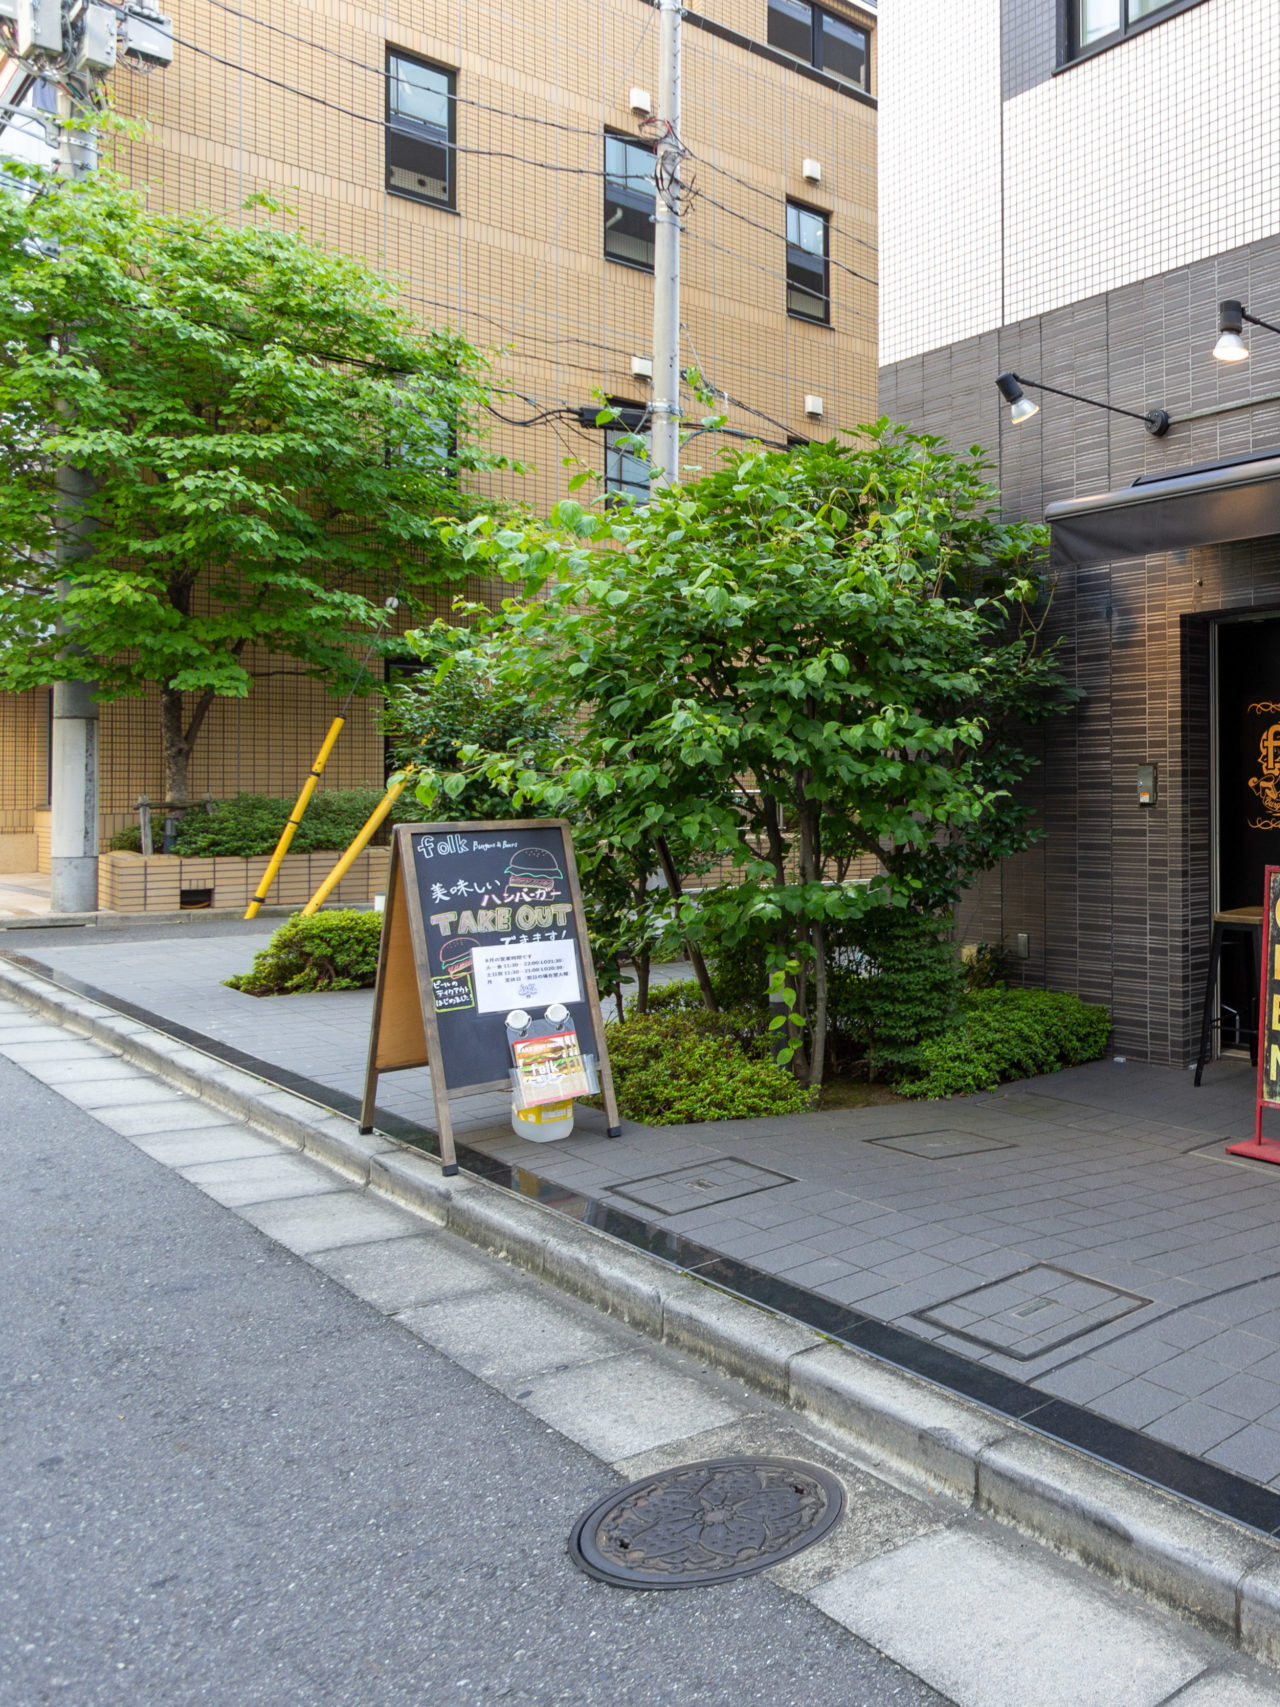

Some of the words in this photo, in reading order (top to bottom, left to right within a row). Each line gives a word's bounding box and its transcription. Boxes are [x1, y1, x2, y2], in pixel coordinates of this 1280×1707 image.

[417, 833, 469, 859] folk
[430, 879, 501, 904] 美味しい
[480, 887, 562, 907] ハンバーガー
[430, 907, 513, 937] TAKE
[515, 903, 573, 931] OUT
[530, 1059, 559, 1076] folk
